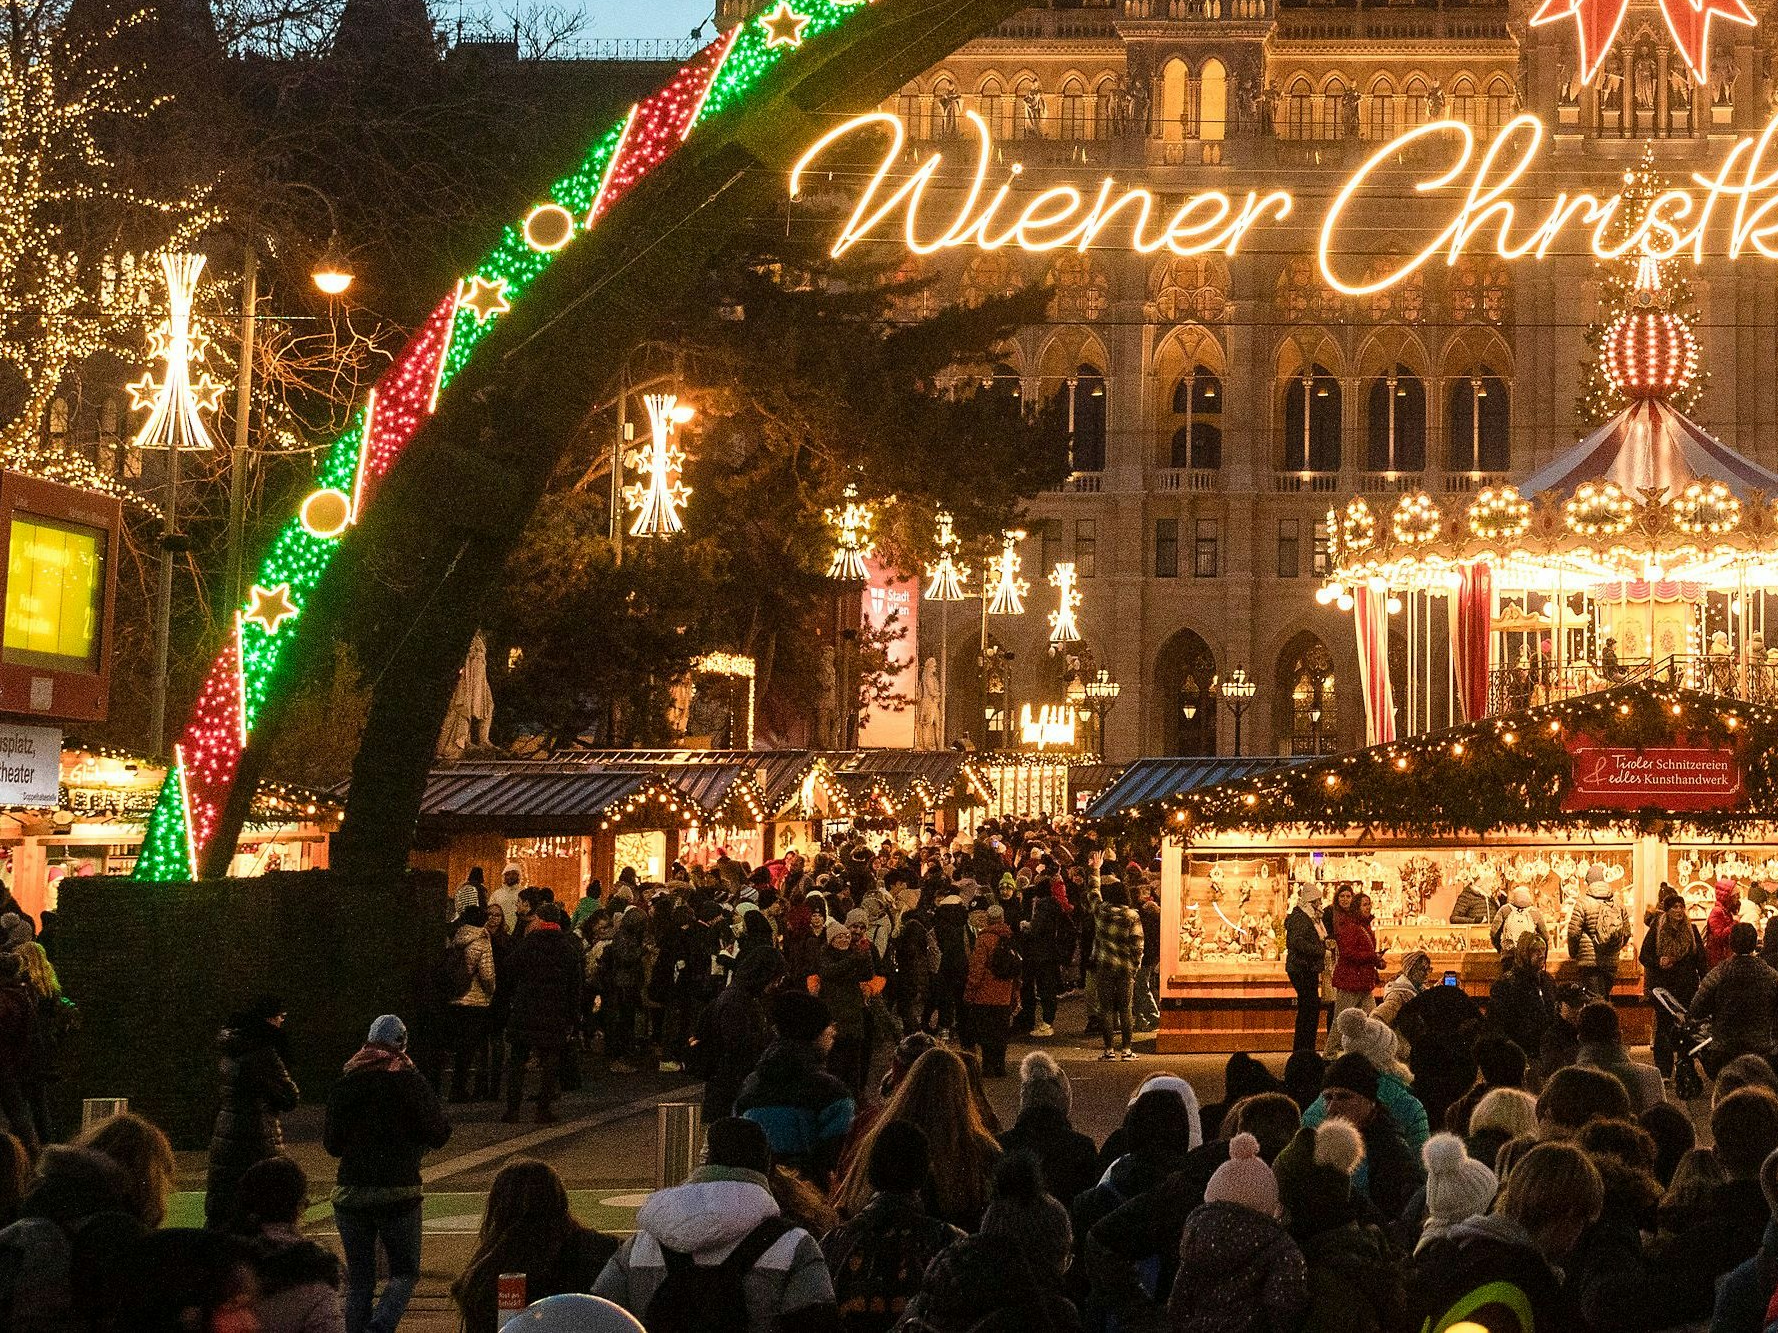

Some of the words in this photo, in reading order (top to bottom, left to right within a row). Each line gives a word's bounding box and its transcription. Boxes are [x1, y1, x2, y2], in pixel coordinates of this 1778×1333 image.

[789, 110, 1292, 259] Wiener
[887, 589, 910, 602] Stadt
[1612, 754, 1654, 770] Tiroler
[1656, 758, 1728, 770] Schnitzereien
[1608, 769, 1641, 784] edles
[1644, 773, 1728, 785] Kunsthandwerk
